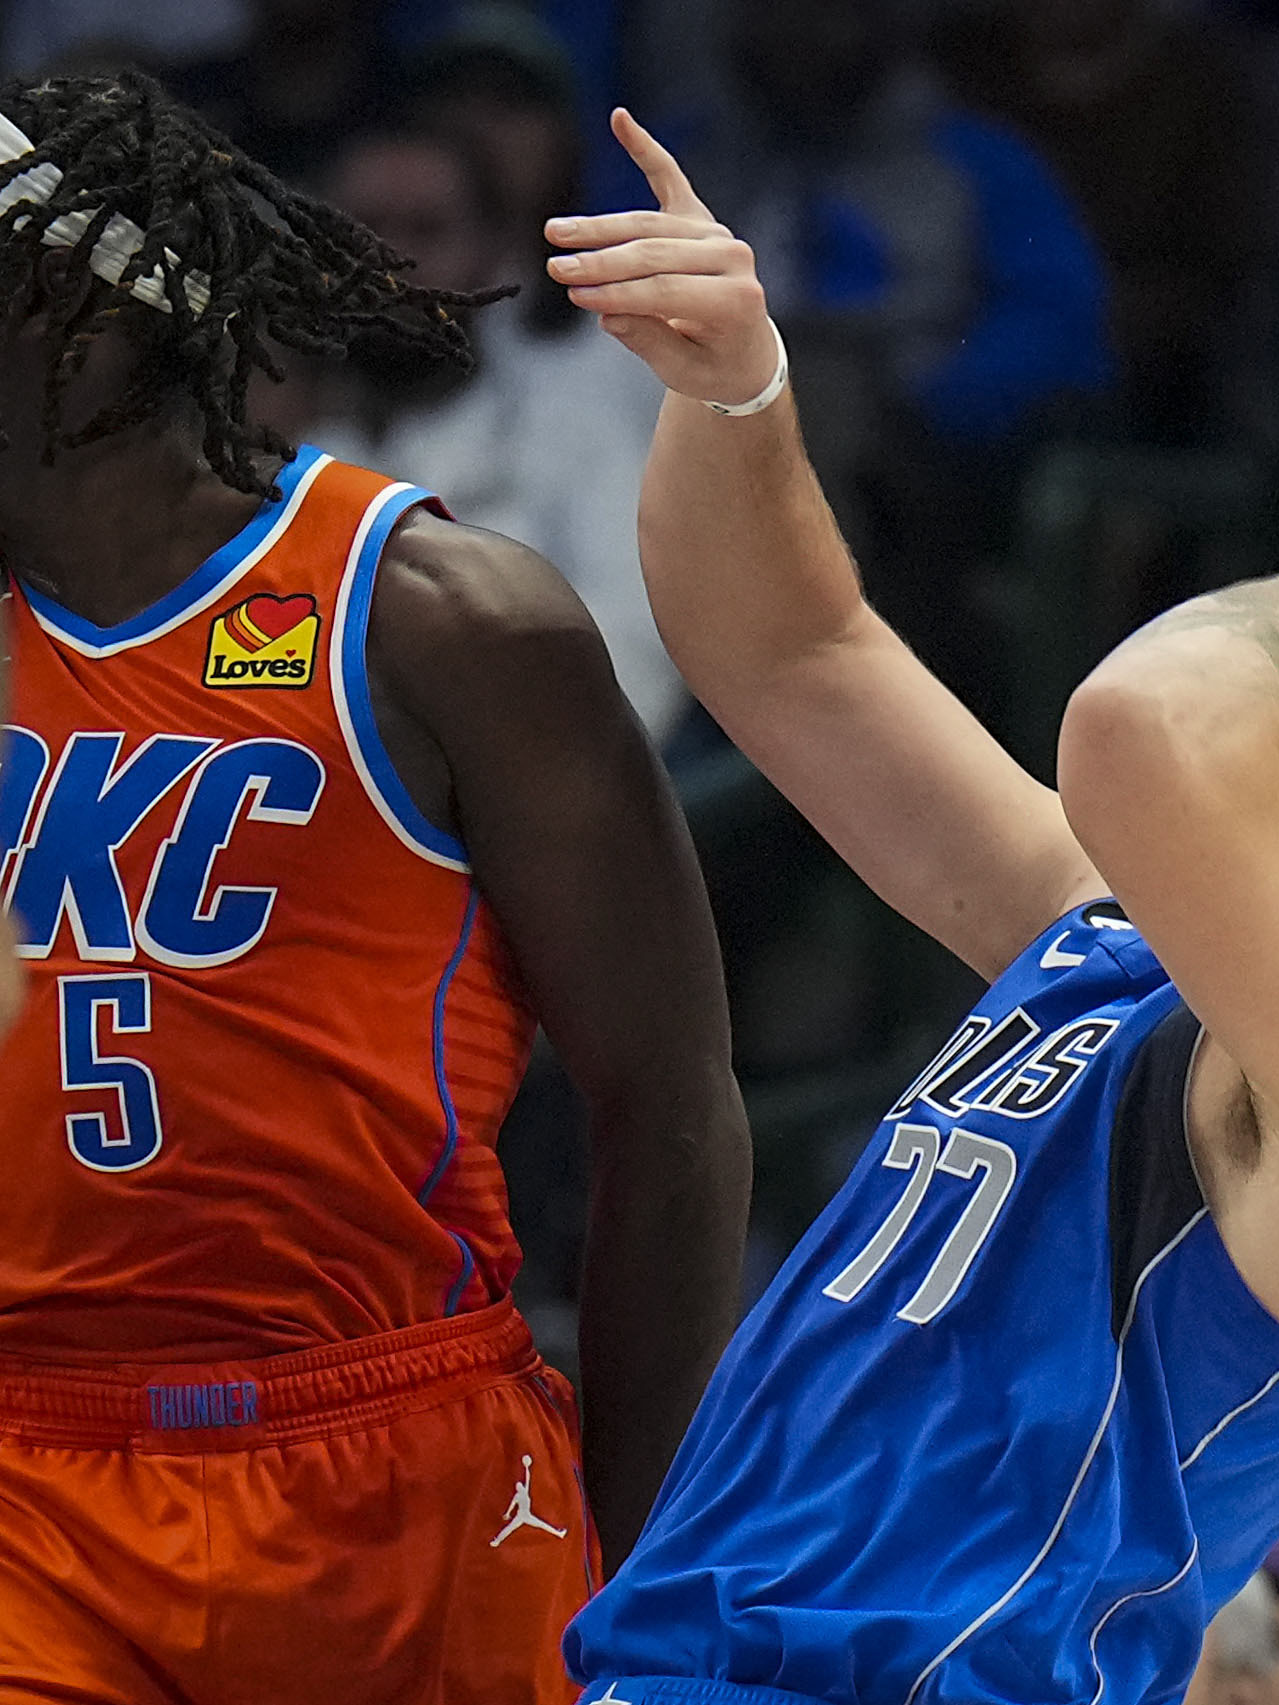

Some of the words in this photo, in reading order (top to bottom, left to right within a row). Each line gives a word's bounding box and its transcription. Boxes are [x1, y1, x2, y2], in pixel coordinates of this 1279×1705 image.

[210, 649, 306, 679] Love's
[57, 971, 163, 1172] 5
[822, 1122, 1017, 1324] 77
[147, 1382, 258, 1429] THUNDER
